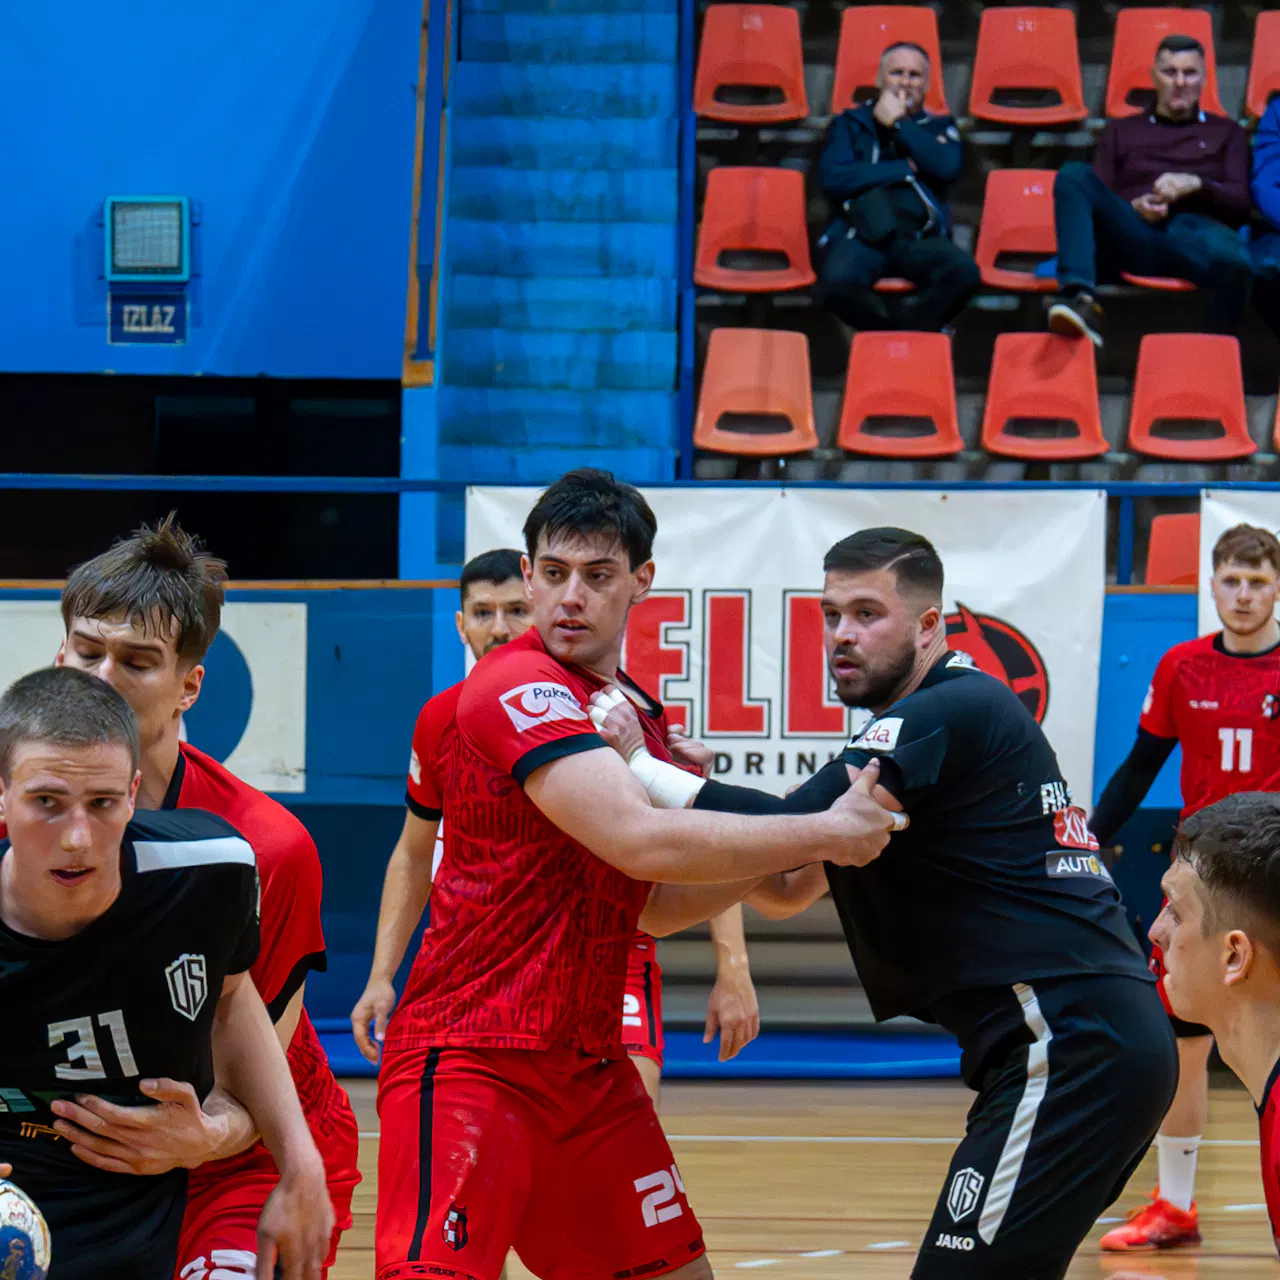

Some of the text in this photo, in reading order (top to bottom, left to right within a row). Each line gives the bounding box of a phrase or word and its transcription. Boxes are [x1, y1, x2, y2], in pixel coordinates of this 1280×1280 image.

[122, 304, 176, 333] IZLAZ
[625, 587, 852, 739] ELL
[713, 751, 834, 775] DRIN
[1218, 727, 1253, 773] 11
[47, 1009, 140, 1081] 31
[935, 1233, 976, 1252] JAKO
